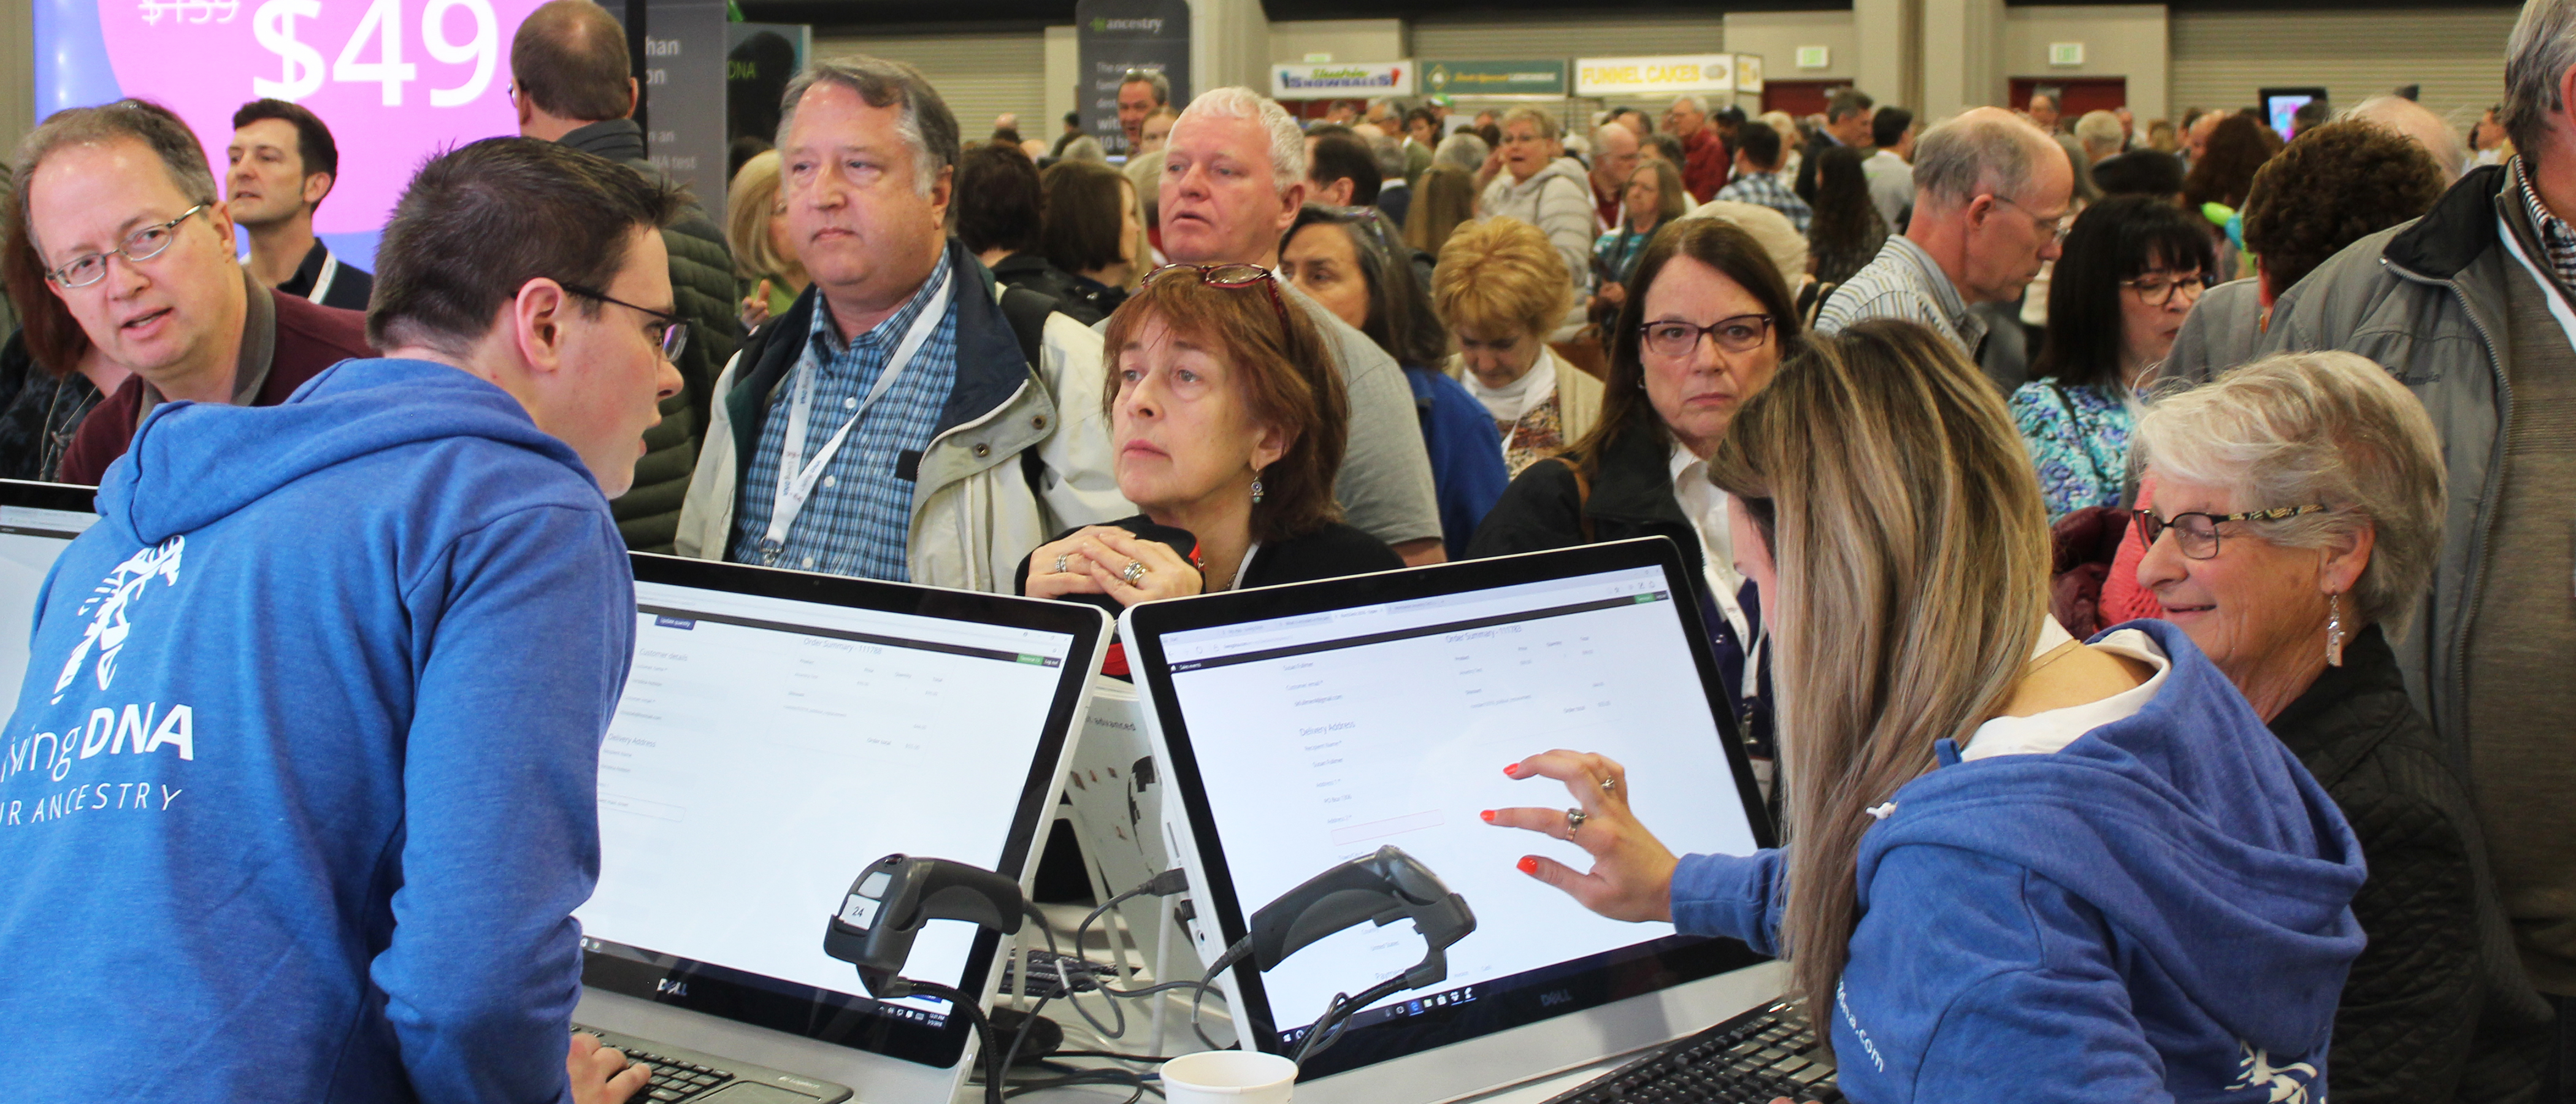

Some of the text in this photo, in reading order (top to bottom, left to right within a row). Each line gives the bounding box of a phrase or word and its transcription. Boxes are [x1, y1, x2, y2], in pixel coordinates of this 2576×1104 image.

[1106, 19, 1162, 34] ancestry
[253, 0, 498, 107] $49
[727, 61, 756, 79] DNA
[1581, 64, 1700, 85] FUNNEL CAKES
[1446, 634, 1464, 643] Order
[1466, 630, 1495, 640] Summary
[803, 638, 823, 647] Order
[823, 640, 853, 653] Summary
[639, 648, 688, 661] Customer details
[1300, 721, 1355, 737] Delivery Address
[608, 732, 656, 748] Delivery Address
[31, 782, 182, 824] ANCESTRY
[852, 906, 864, 918] 24
[656, 978, 687, 996] DELL
[1540, 989, 1573, 1006] DELL
